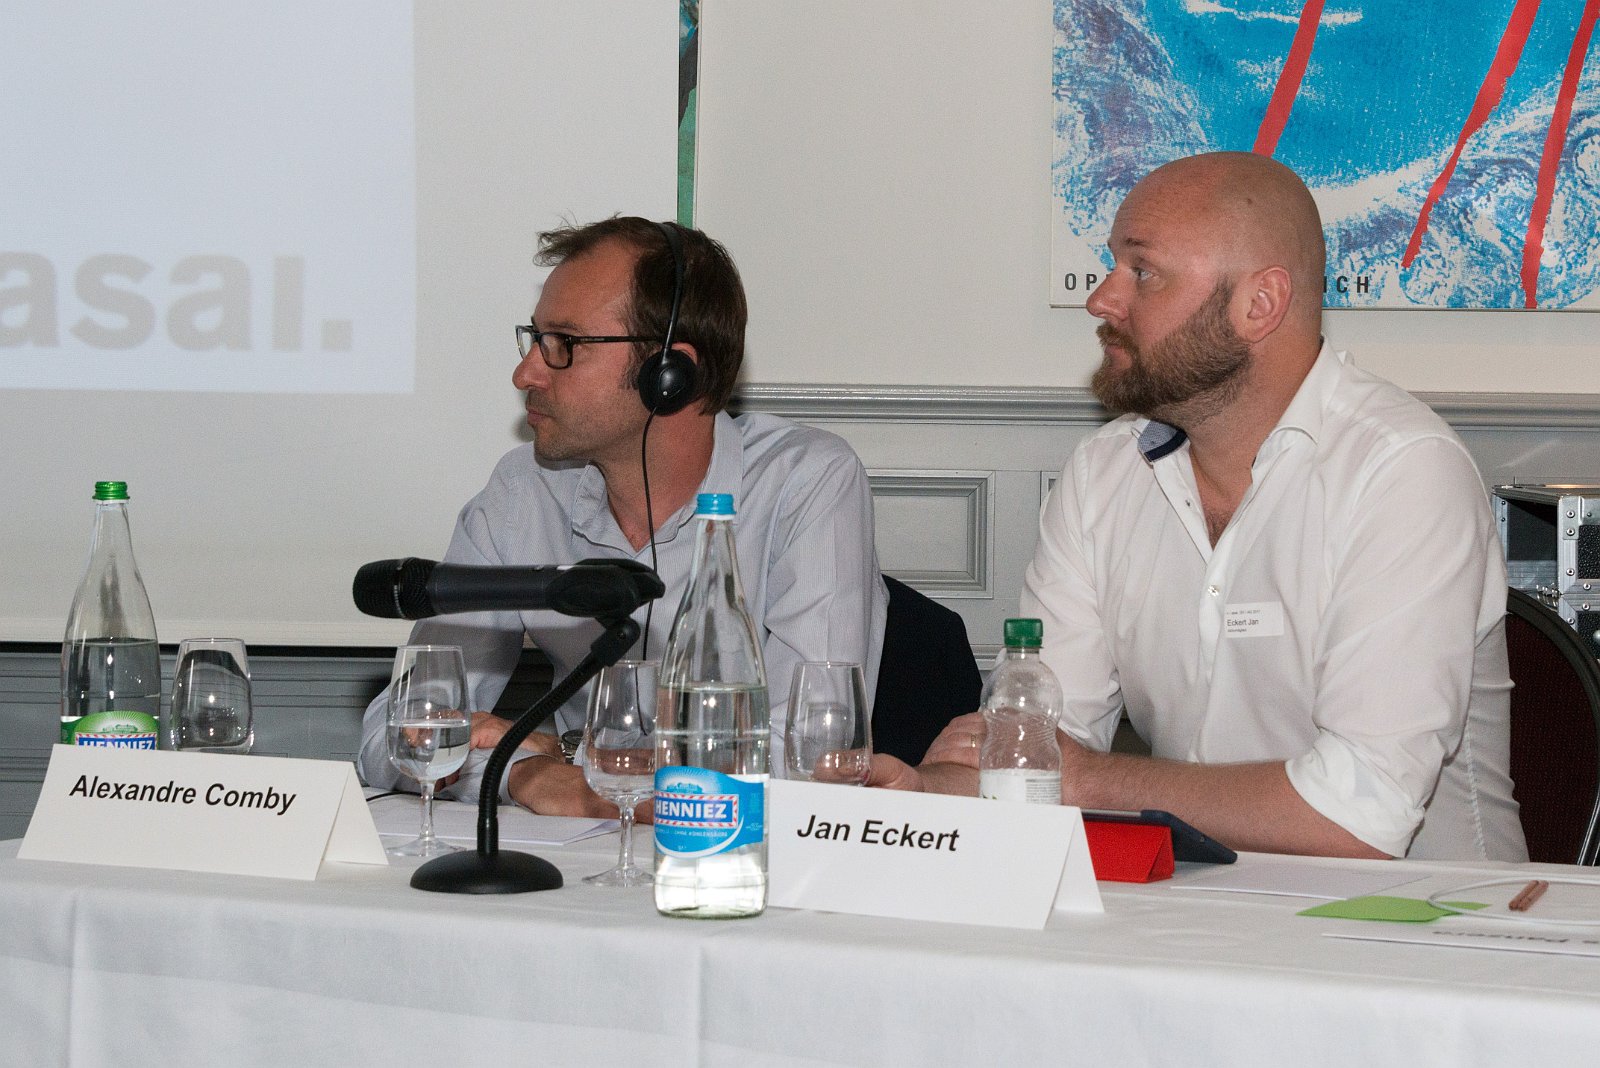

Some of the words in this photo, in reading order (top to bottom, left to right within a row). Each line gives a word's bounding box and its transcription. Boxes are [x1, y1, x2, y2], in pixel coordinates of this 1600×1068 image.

[1065, 273, 1110, 290] OP
[1323, 276, 1369, 293] ICH
[1227, 619, 1247, 627] Eckert
[1247, 618, 1259, 626] Jan
[69, 775, 197, 804] Alexandre
[205, 783, 297, 816] Comby
[656, 799, 727, 819] HENNIEZ
[797, 814, 851, 841] Jan
[860, 819, 960, 852] Eckert
